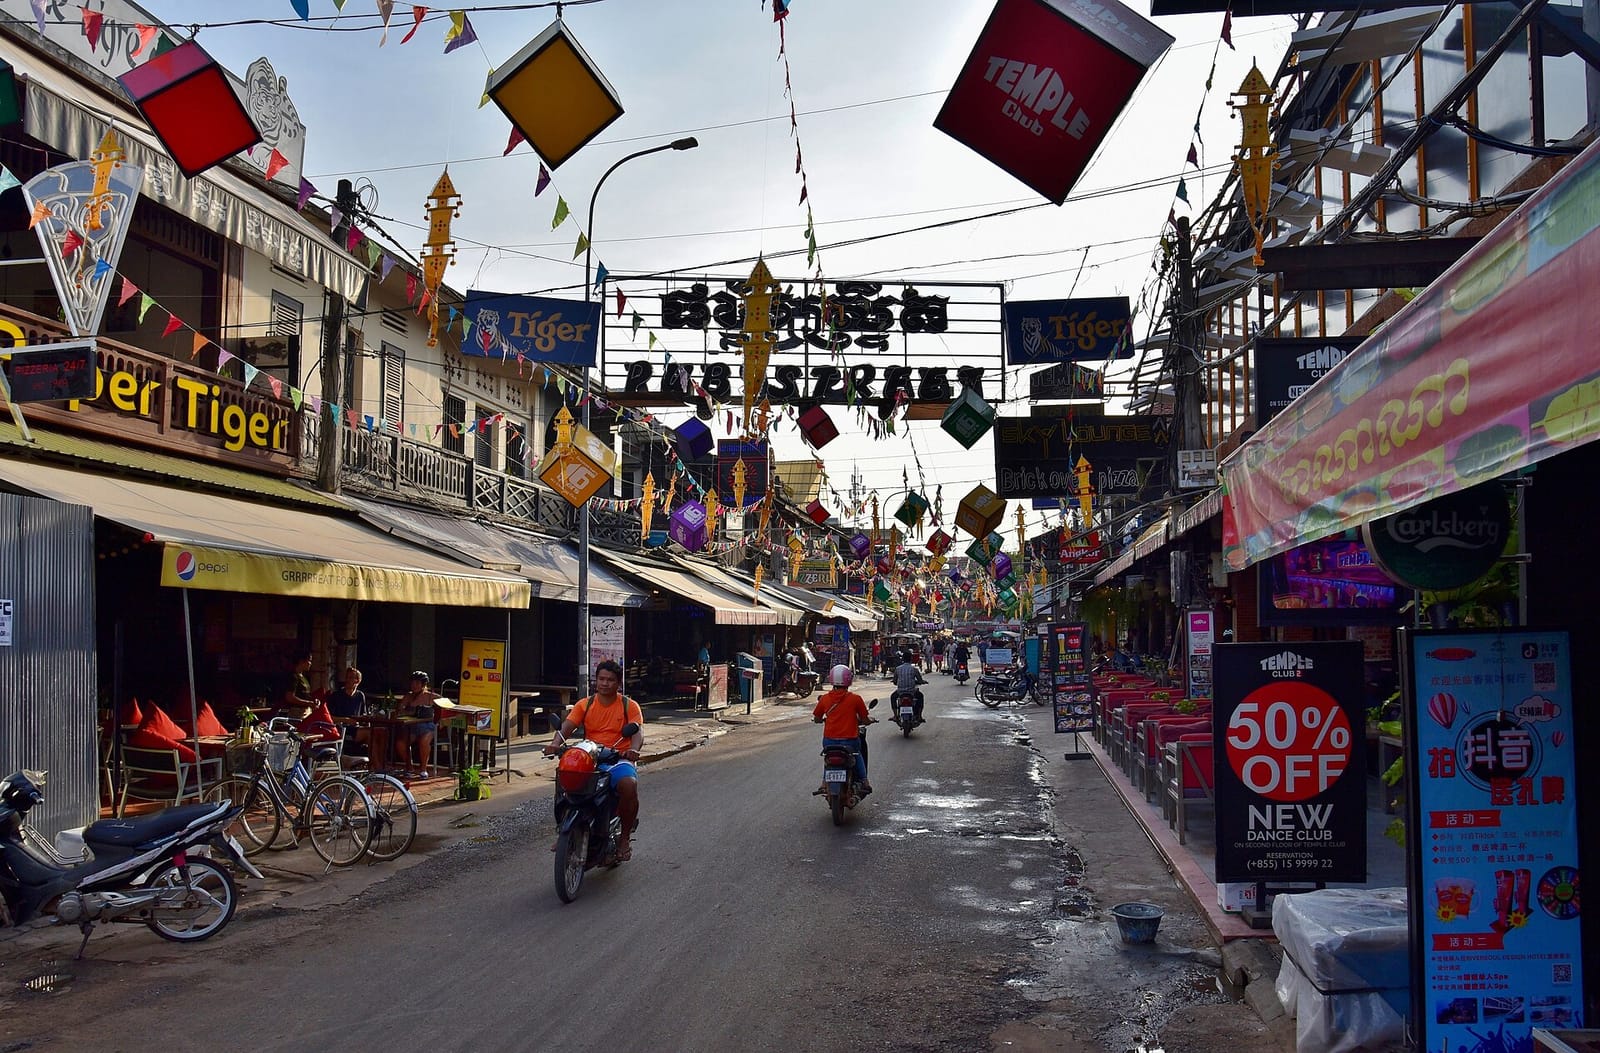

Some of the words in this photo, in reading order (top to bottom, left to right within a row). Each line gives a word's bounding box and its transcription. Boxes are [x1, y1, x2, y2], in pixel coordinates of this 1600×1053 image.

[983, 56, 1090, 140] TEMPLE
[1001, 99, 1044, 136] Club
[507, 311, 592, 352] Tiger
[1048, 312, 1126, 350] Tiger
[624, 361, 731, 398] PUB
[767, 362, 985, 402] STREET
[177, 377, 290, 451] Tiger
[1001, 467, 1046, 492] Brick
[1098, 468, 1139, 495] pizza
[1386, 508, 1500, 546] Carlsberg
[198, 562, 229, 574] pepsi
[336, 575, 360, 587] FOOD
[1260, 651, 1314, 671] TEMPLE
[1272, 670, 1295, 678] CLUB
[1227, 701, 1350, 750] 50%
[1428, 747, 1456, 778] 拍
[1463, 727, 1531, 771] 抖音
[1242, 754, 1346, 794] OFF
[1247, 830, 1293, 841] DANCE
[1296, 829, 1333, 841] CLUB
[1248, 804, 1333, 830] NEW
[1247, 859, 1278, 871] (+855)
[1282, 859, 1293, 868] 15
[1295, 859, 1318, 868] 9999
[1321, 859, 1333, 868] 22
